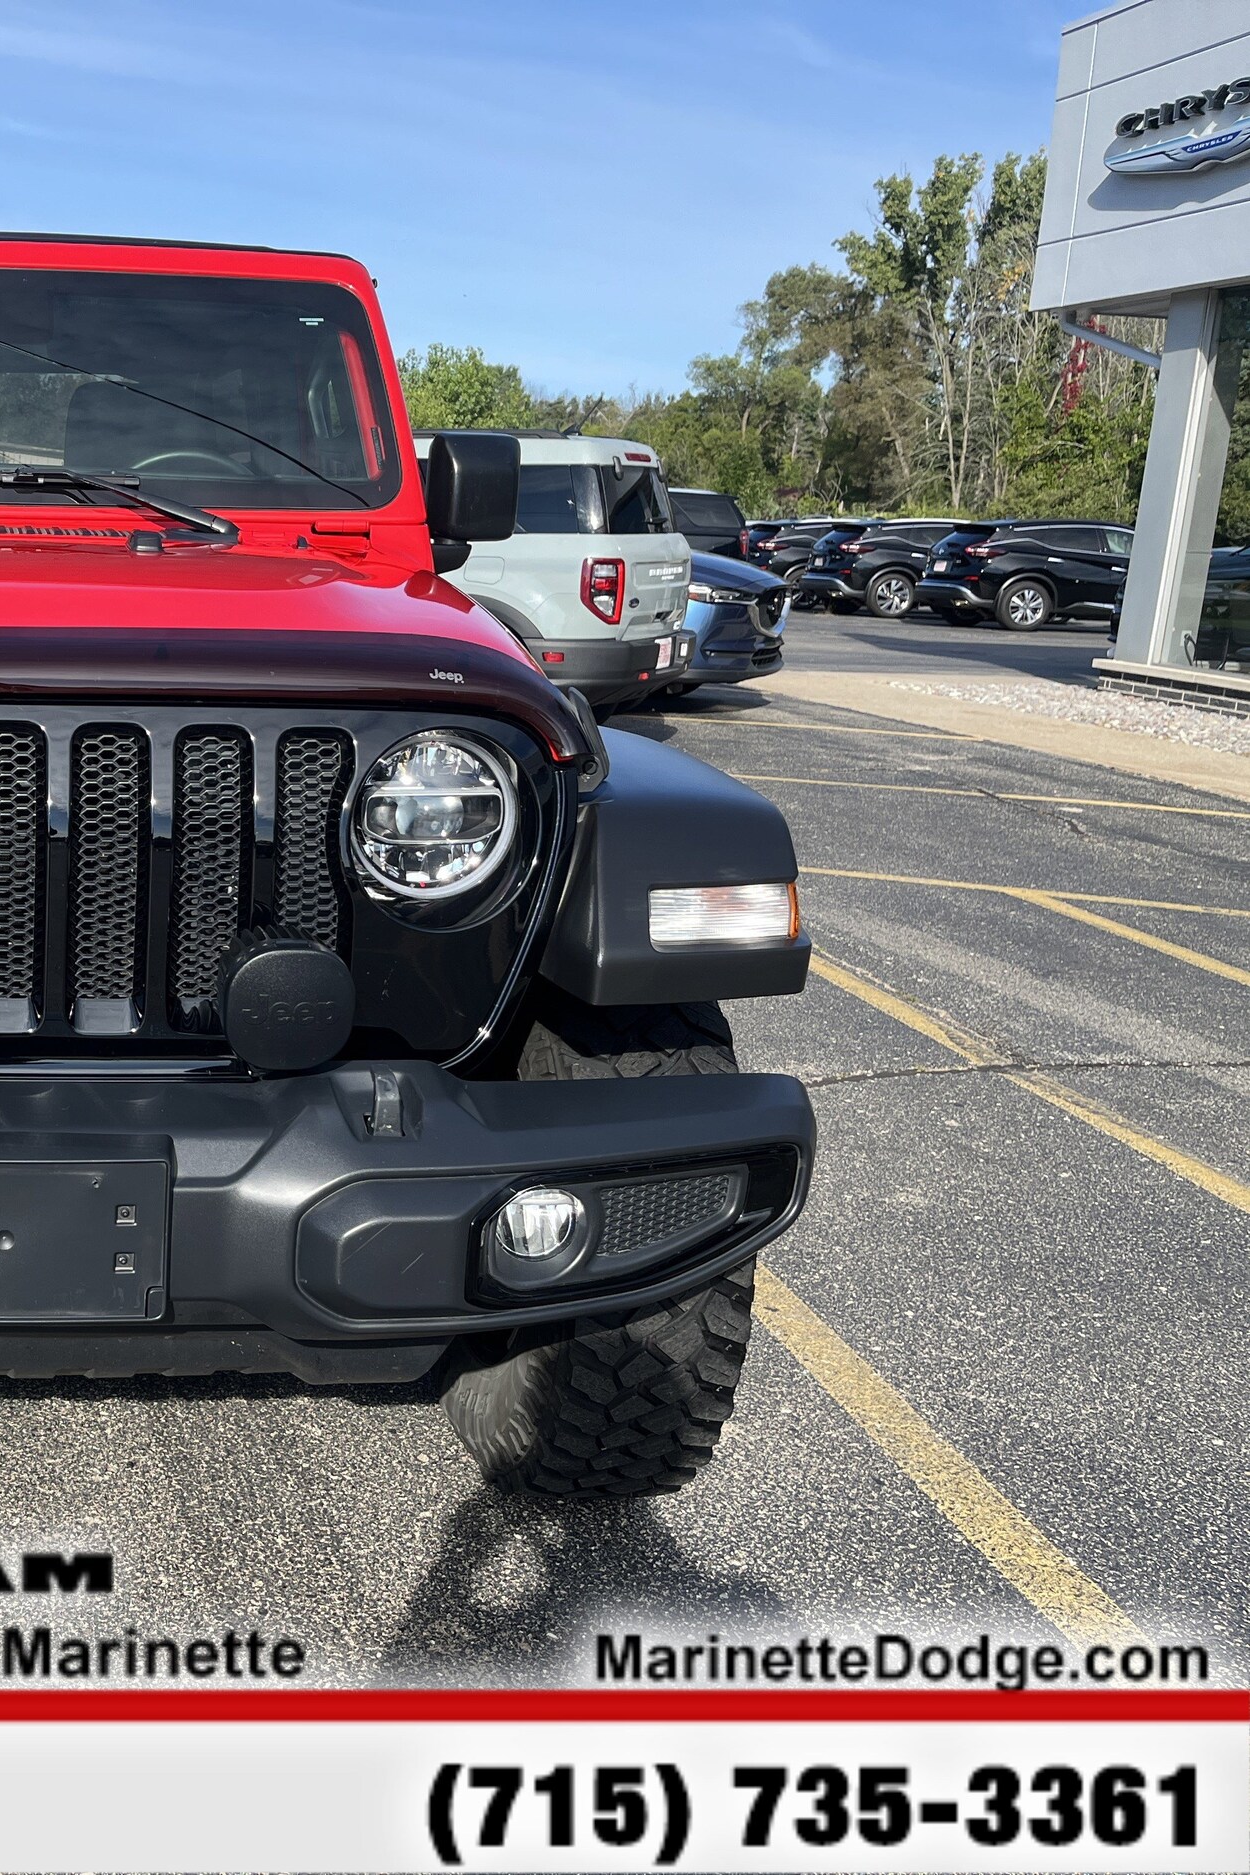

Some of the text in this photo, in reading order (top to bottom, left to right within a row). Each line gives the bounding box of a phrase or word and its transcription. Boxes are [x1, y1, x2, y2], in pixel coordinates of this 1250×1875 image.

[1186, 134, 1235, 152] CHRYSLER
[429, 668, 464, 684] Jeep
[241, 993, 338, 1032] Jeep
